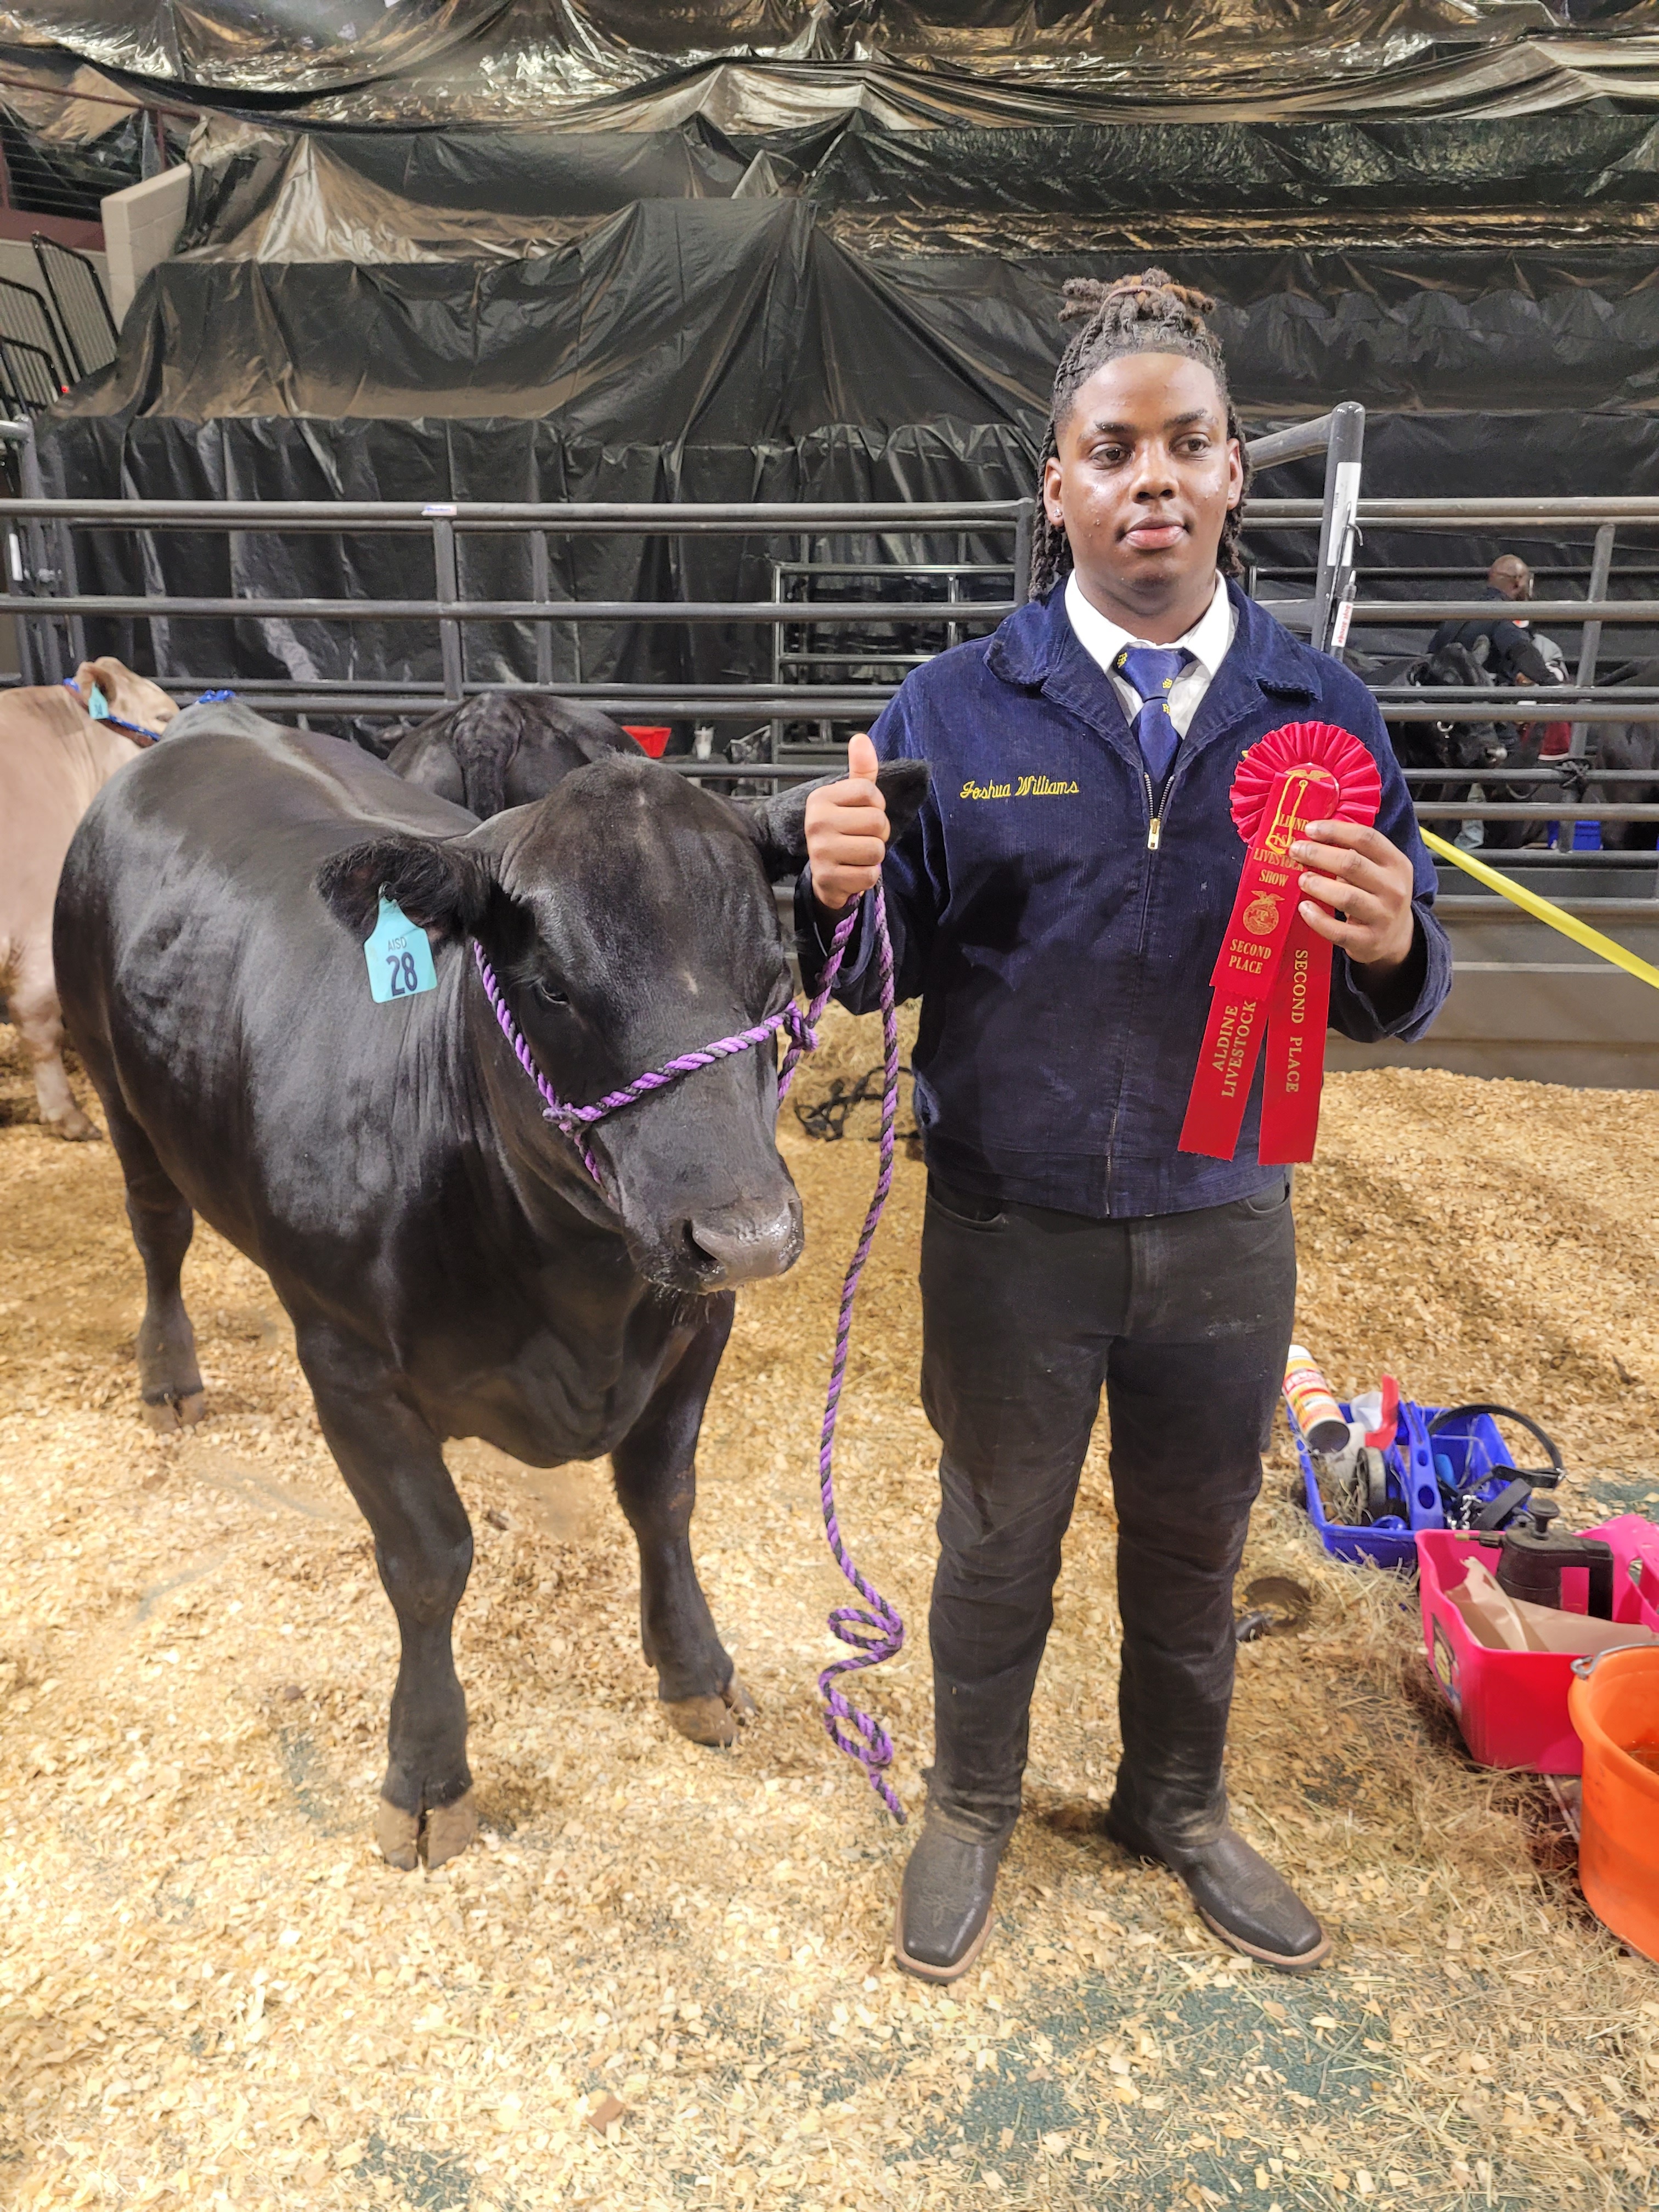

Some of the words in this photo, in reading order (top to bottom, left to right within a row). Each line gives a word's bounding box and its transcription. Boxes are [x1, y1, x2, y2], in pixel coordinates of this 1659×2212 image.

[960, 779, 1011, 799] Joshua
[1015, 775, 1080, 796] Williams
[1259, 868, 1289, 887] SHOW
[388, 936, 407, 952] AISD
[1229, 939, 1272, 960] SECOND
[386, 952, 417, 996] 28
[1228, 955, 1263, 974] PLACE
[1291, 949, 1308, 1024] SECOND
[1212, 1006, 1238, 1071] ALDINE
[1221, 1000, 1256, 1098] LIVESTOCK
[1286, 1036, 1303, 1092] PLACE
